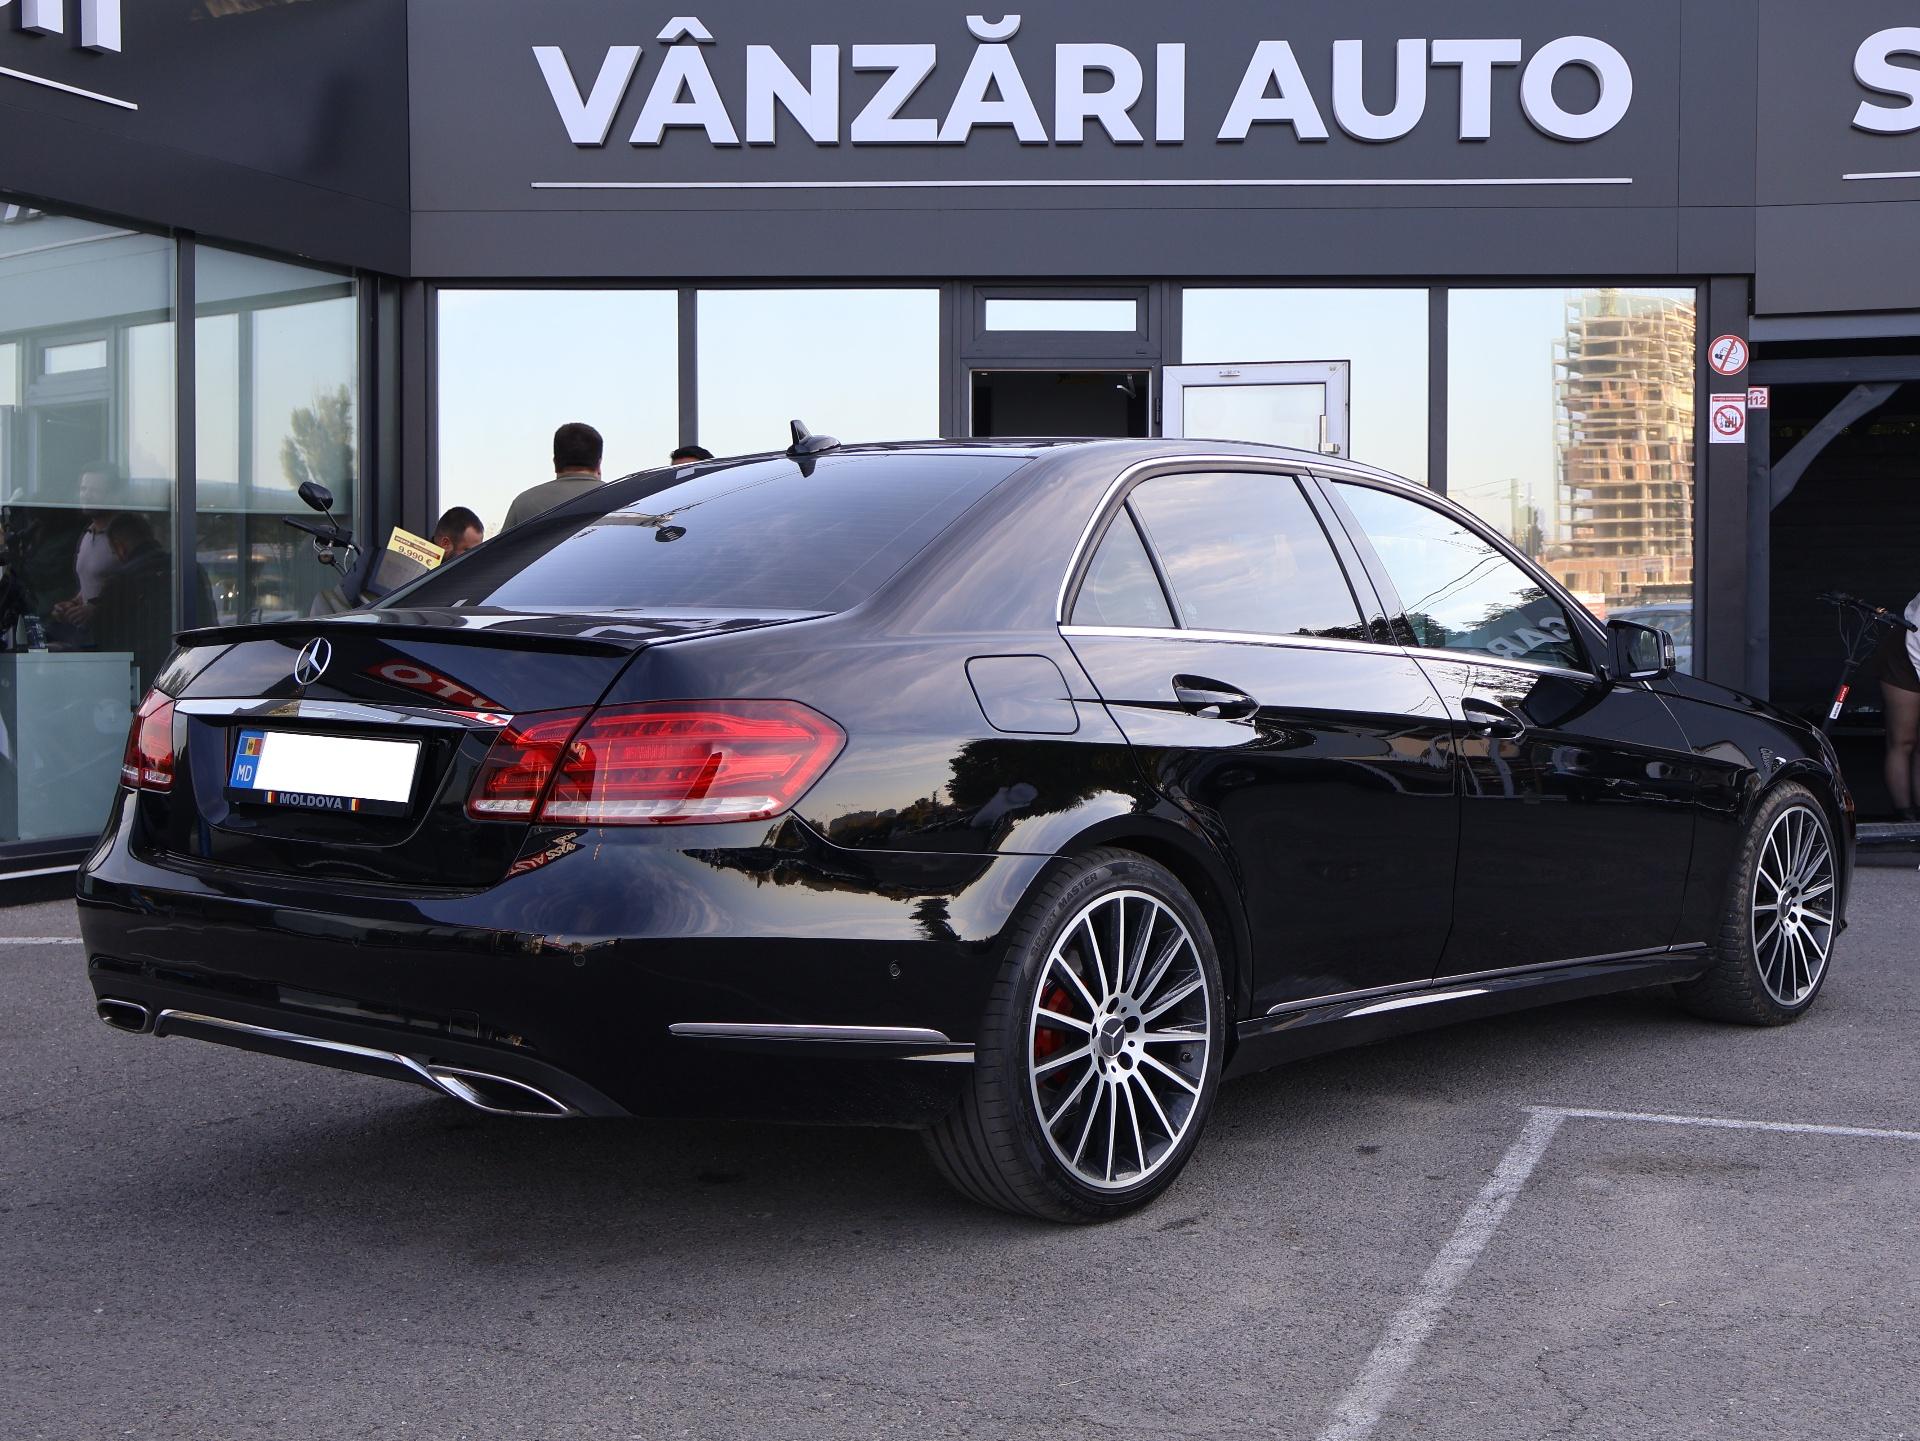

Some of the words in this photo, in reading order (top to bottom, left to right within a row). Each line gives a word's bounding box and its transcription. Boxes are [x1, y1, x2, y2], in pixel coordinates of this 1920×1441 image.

[531, 14, 1186, 146] VÂNZĂRI
[1216, 35, 1633, 142] AUTO
[1749, 396, 1766, 405] 112
[236, 764, 253, 782] MD
[279, 792, 343, 809] MOLDOVA
[1058, 872, 1099, 910] MASTER
